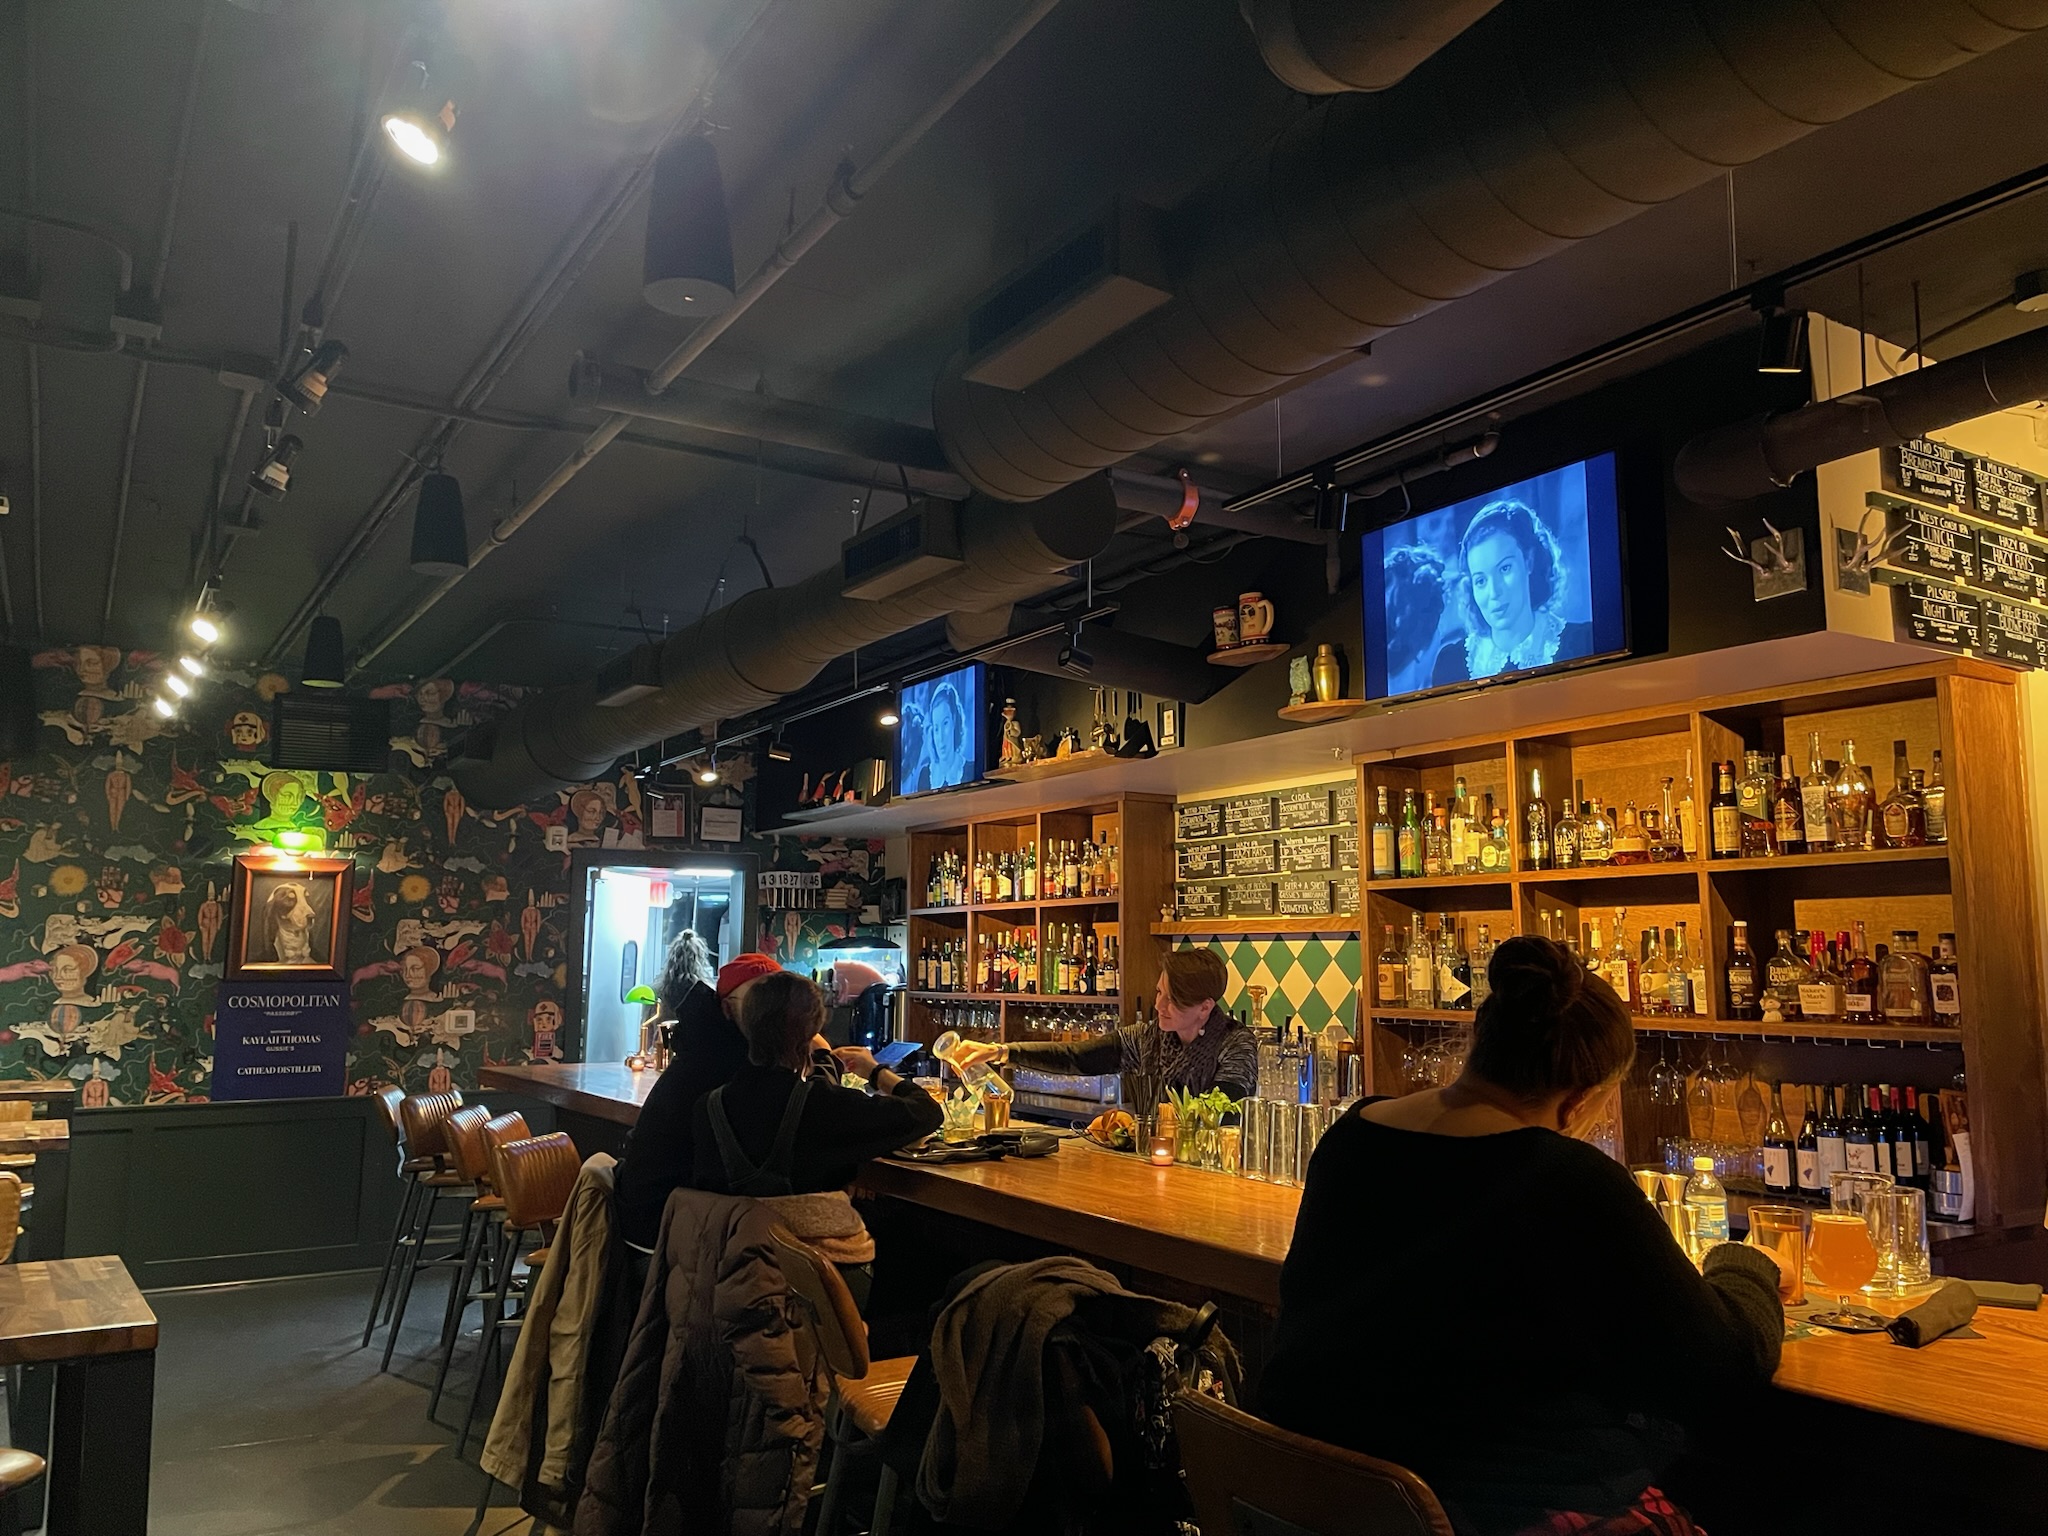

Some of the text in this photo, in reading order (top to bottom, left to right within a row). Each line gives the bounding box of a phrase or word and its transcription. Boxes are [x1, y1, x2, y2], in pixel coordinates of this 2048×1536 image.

[1910, 439, 1954, 461] NITRO STOUT
[1901, 449, 1942, 474] BREAKFAST
[1944, 461, 1965, 481] STOUT
[1987, 462, 2023, 483] MILK STOUT
[1918, 510, 1939, 525] WEST
[1921, 524, 1955, 549] LUNCH
[1998, 535, 2018, 550] HAZY
[1992, 547, 2034, 572] HAZY RAYS
[1926, 584, 1957, 603] PILSNER
[1922, 599, 1970, 623] RIGHT TIME
[1291, 792, 1311, 802] CIDER
[1233, 847, 1267, 860] HAZY RAYS
[1280, 845, 1290, 856] UP
[1187, 853, 1208, 863] LUNCH
[769, 874, 775, 885] 3
[778, 874, 789, 885] 18
[1310, 881, 1326, 890] SHOT
[1184, 894, 1215, 905] RIGHT TIME
[1280, 901, 1310, 914] BUDWEISER
[228, 995, 341, 1008] COSMOPOLITAN
[242, 1035, 321, 1045] KAYLAH THOMAS
[237, 1065, 321, 1075] CATHEAD DISTILLERY
